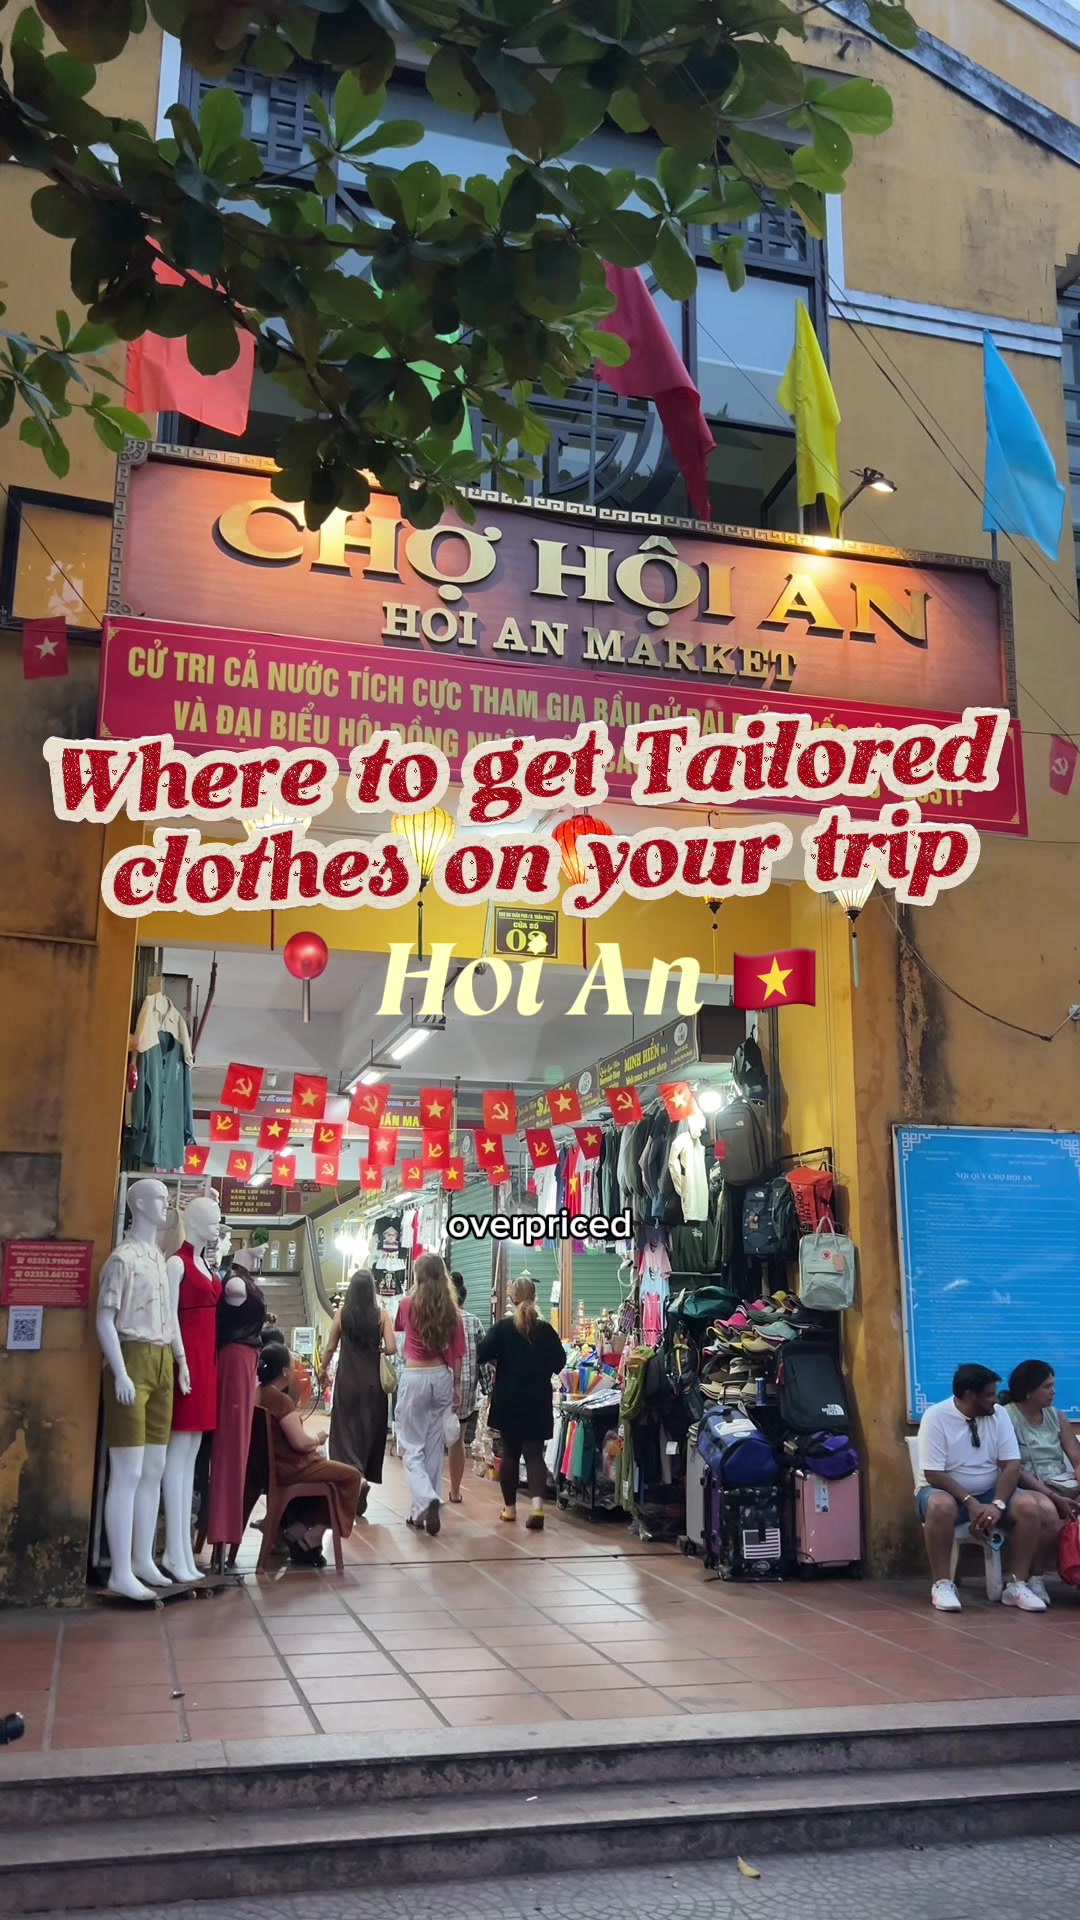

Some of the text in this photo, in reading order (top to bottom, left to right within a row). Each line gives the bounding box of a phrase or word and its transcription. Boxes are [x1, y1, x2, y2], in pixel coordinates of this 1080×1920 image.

[218, 500, 929, 642] CHỢ HỘI AN
[128, 639, 168, 679] CỬ
[174, 651, 215, 684] TRI
[224, 649, 259, 689] CẢ
[268, 660, 340, 698] NƯỚC
[348, 667, 404, 705] TÍCH
[412, 677, 462, 715] CỰC
[470, 684, 539, 720] THAM
[546, 692, 586, 723] GIA
[382, 601, 798, 682] HOI AN MARKET
[174, 696, 208, 733] VÀ
[215, 705, 262, 743] ĐẠI
[270, 702, 330, 745] BIỂU
